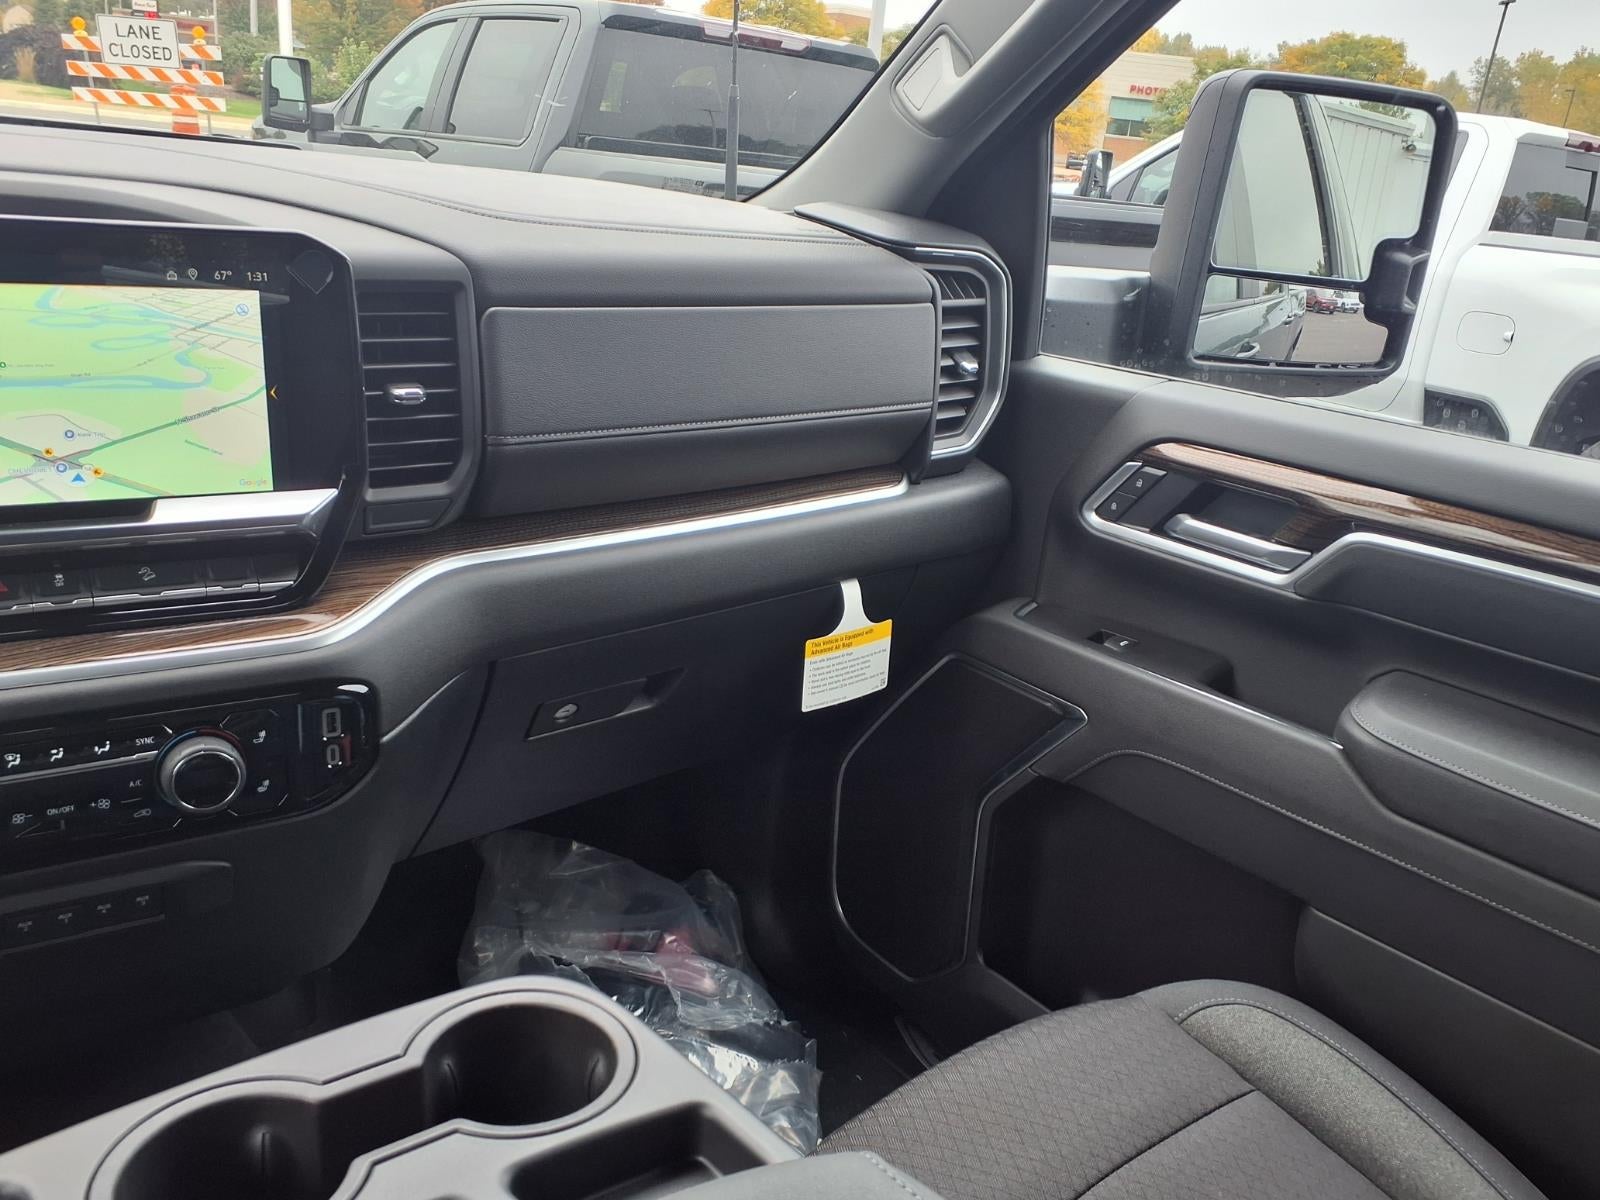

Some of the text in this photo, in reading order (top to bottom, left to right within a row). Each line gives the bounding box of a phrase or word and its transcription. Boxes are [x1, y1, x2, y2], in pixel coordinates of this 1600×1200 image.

[115, 23, 162, 41] LANE
[109, 43, 173, 61] CLOSED
[246, 271, 268, 282] 1:31
[811, 640, 822, 648] This
[135, 736, 155, 746] SYNC
[129, 779, 143, 788] A/C
[46, 804, 75, 816] ON/OFF
